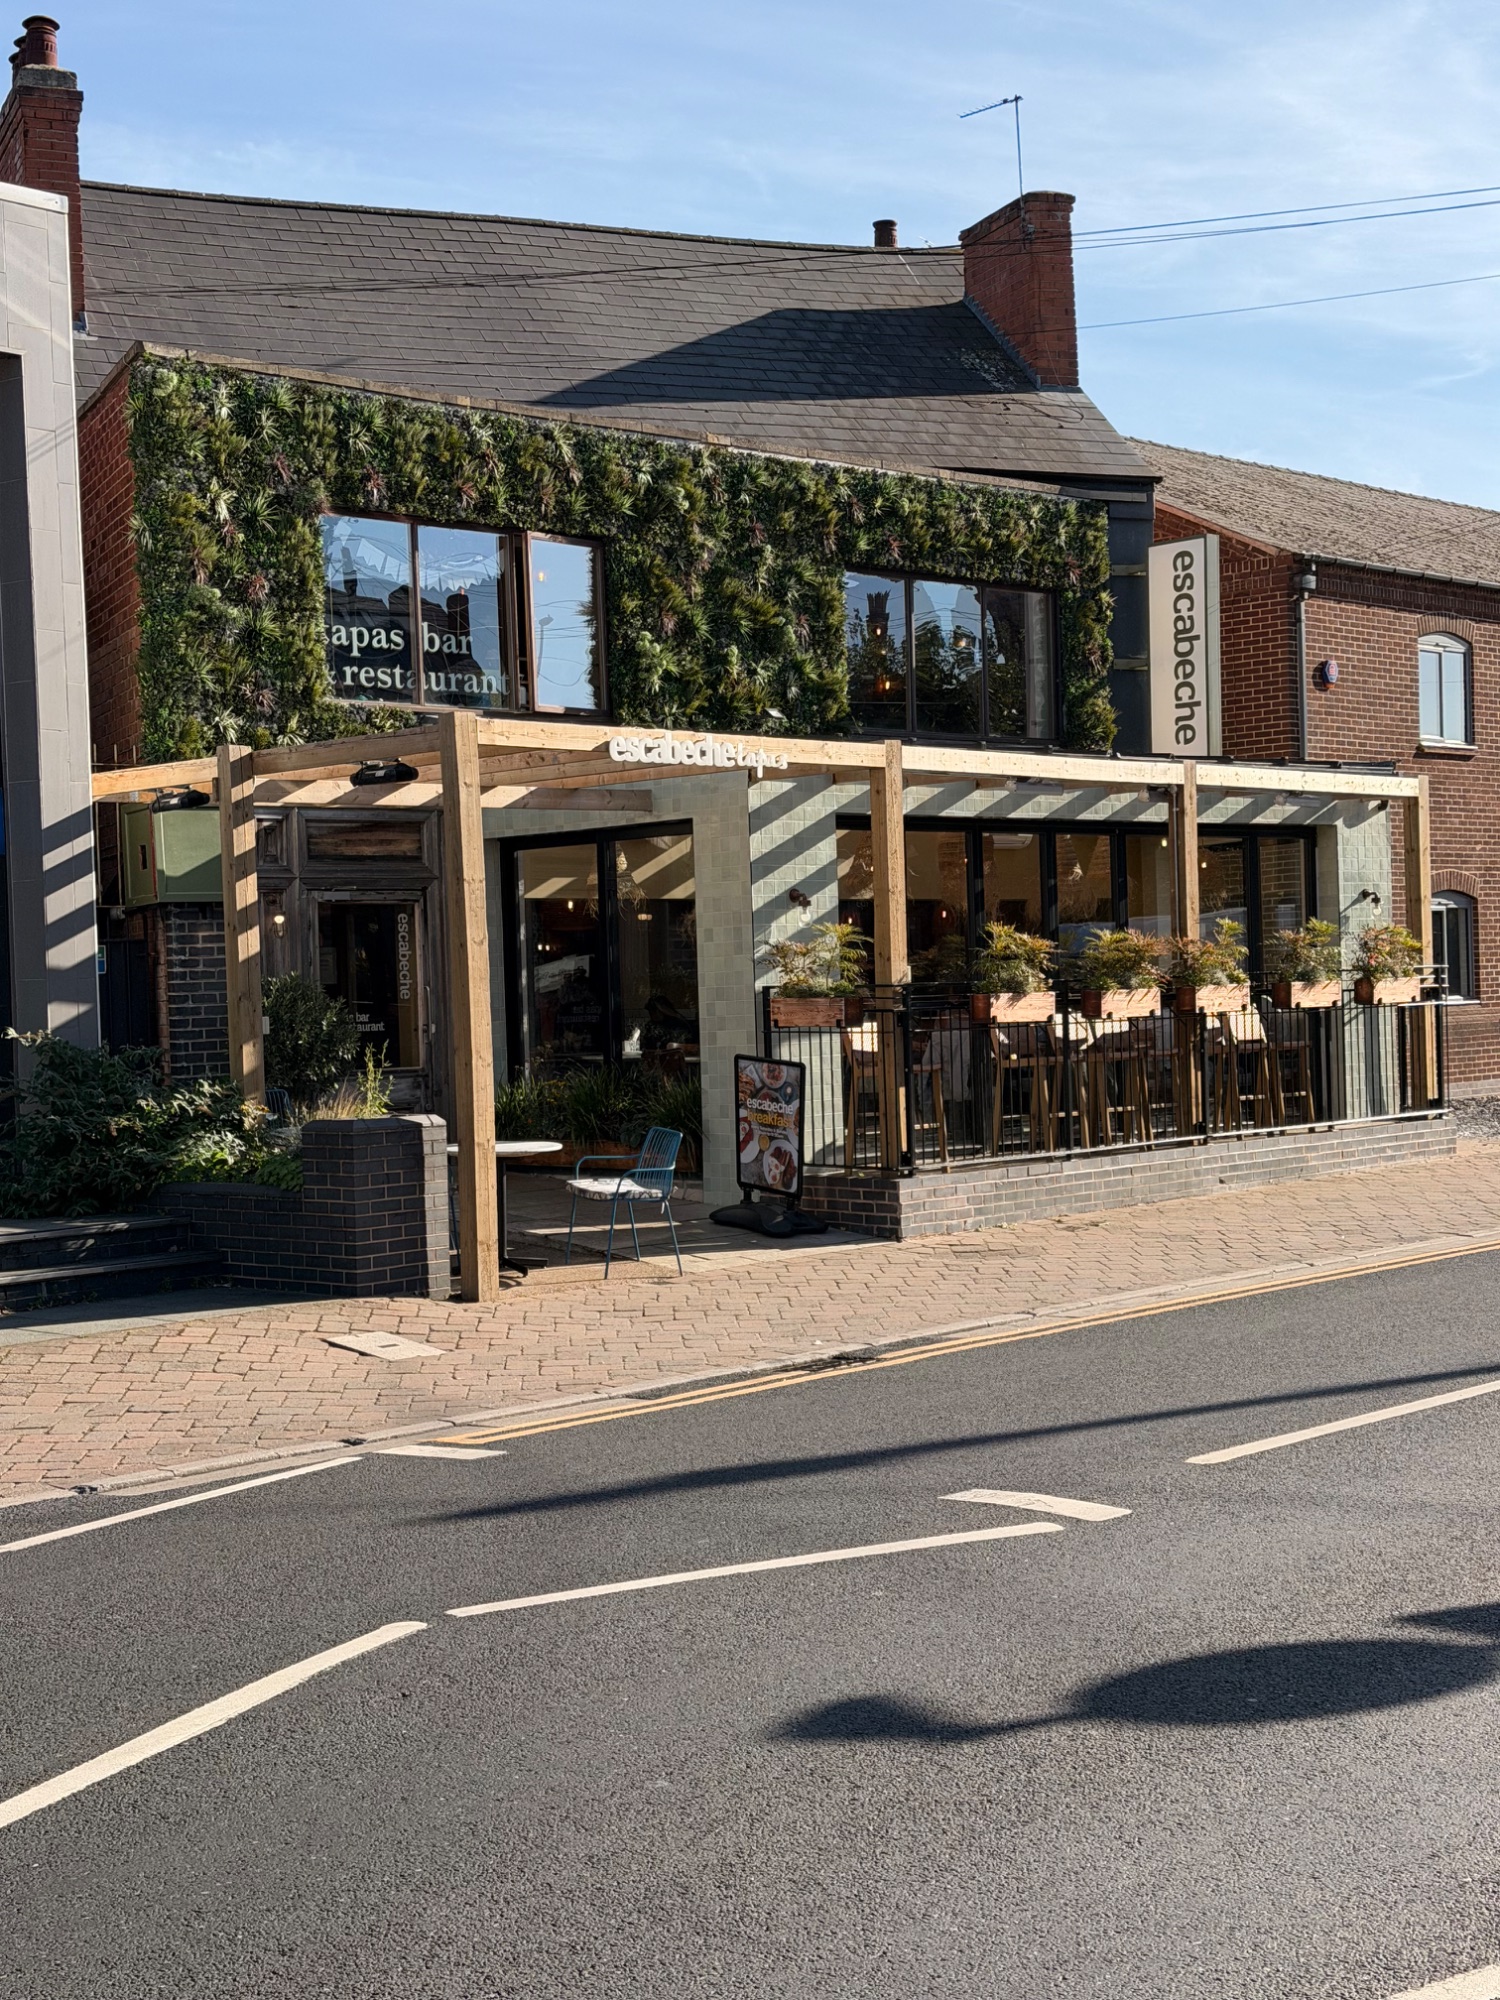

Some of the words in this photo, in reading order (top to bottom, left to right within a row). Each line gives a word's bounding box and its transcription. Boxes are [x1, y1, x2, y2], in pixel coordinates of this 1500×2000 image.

[421, 622, 473, 655] bar
[1172, 550, 1202, 746] escabeche
[342, 662, 511, 696] restaurant
[609, 732, 737, 768] escabeche
[397, 912, 414, 1000] escabeche
[355, 1011, 371, 1023] bar
[746, 1097, 794, 1115] escabeche
